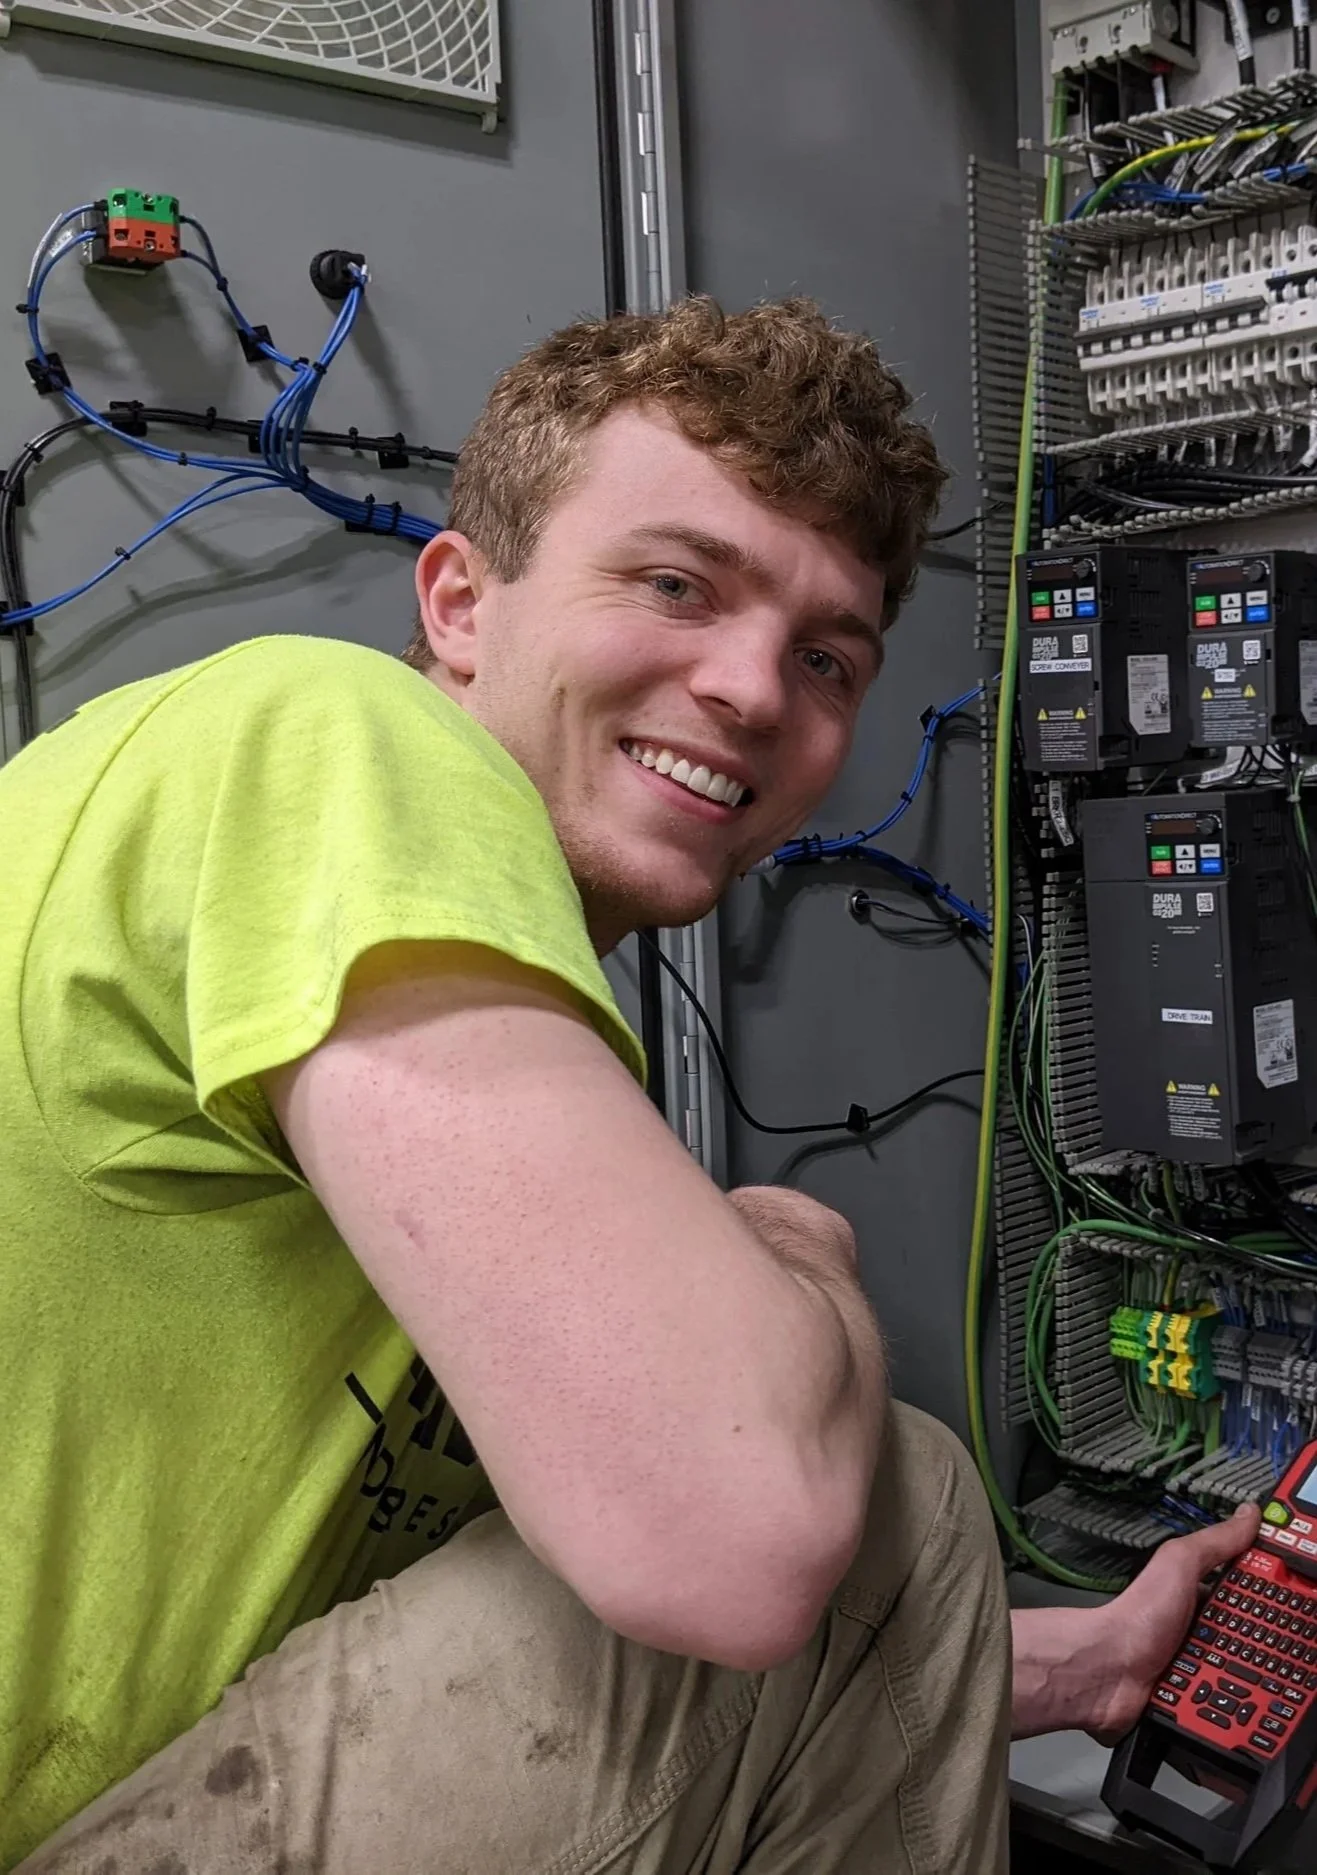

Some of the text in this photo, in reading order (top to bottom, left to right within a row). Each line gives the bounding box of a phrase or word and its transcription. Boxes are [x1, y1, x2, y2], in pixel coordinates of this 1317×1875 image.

[1033, 636, 1058, 647] DURA
[1197, 642, 1227, 654] DURA
[1031, 663, 1052, 671] SCREW
[1153, 893, 1181, 903] DURA
[1167, 1012, 1211, 1022] DRIVE TRAIN
